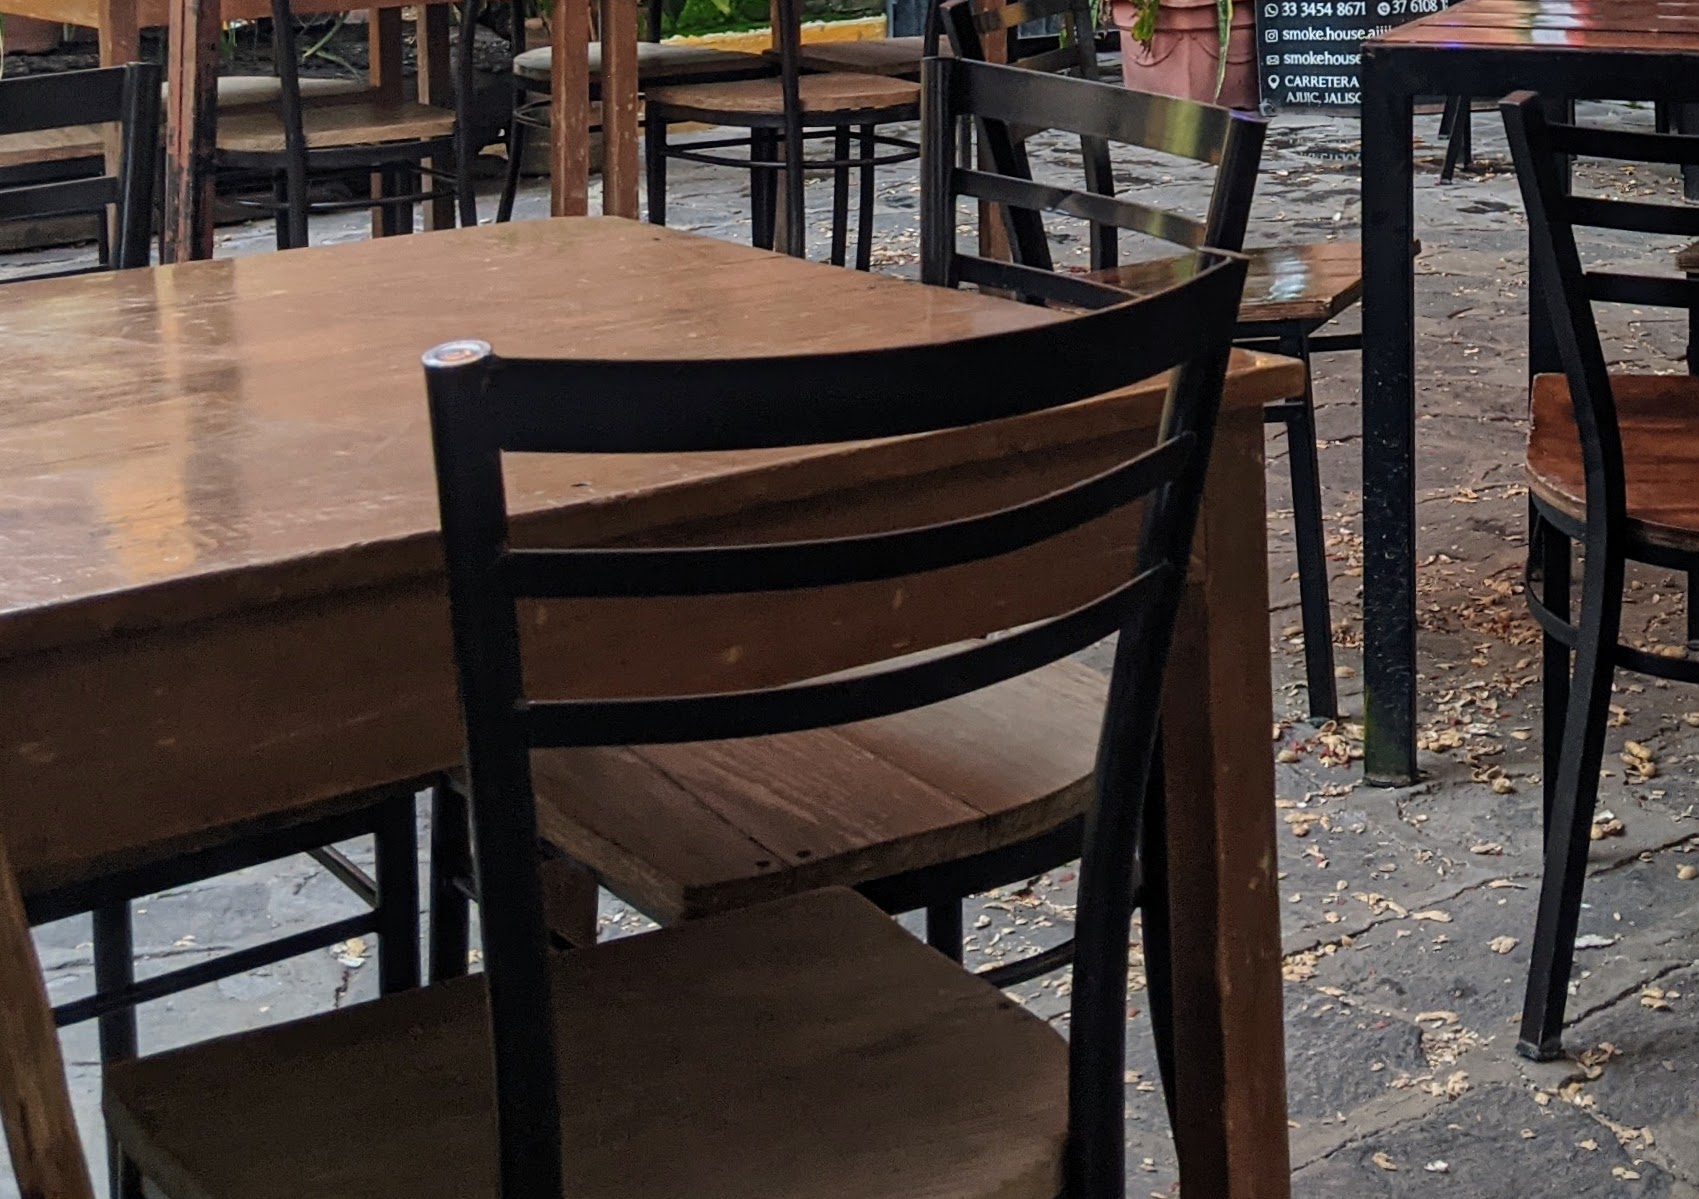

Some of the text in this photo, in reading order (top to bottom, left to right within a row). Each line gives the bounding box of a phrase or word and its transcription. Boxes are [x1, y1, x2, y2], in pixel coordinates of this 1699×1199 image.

[1281, 2, 1297, 17] 33
[1301, 1, 1333, 18] 3454
[1336, 1, 1367, 17] 8671
[1391, 0, 1408, 14] 37
[1284, 75, 1360, 89] CARRETERA
[1323, 91, 1362, 105] JALISC
